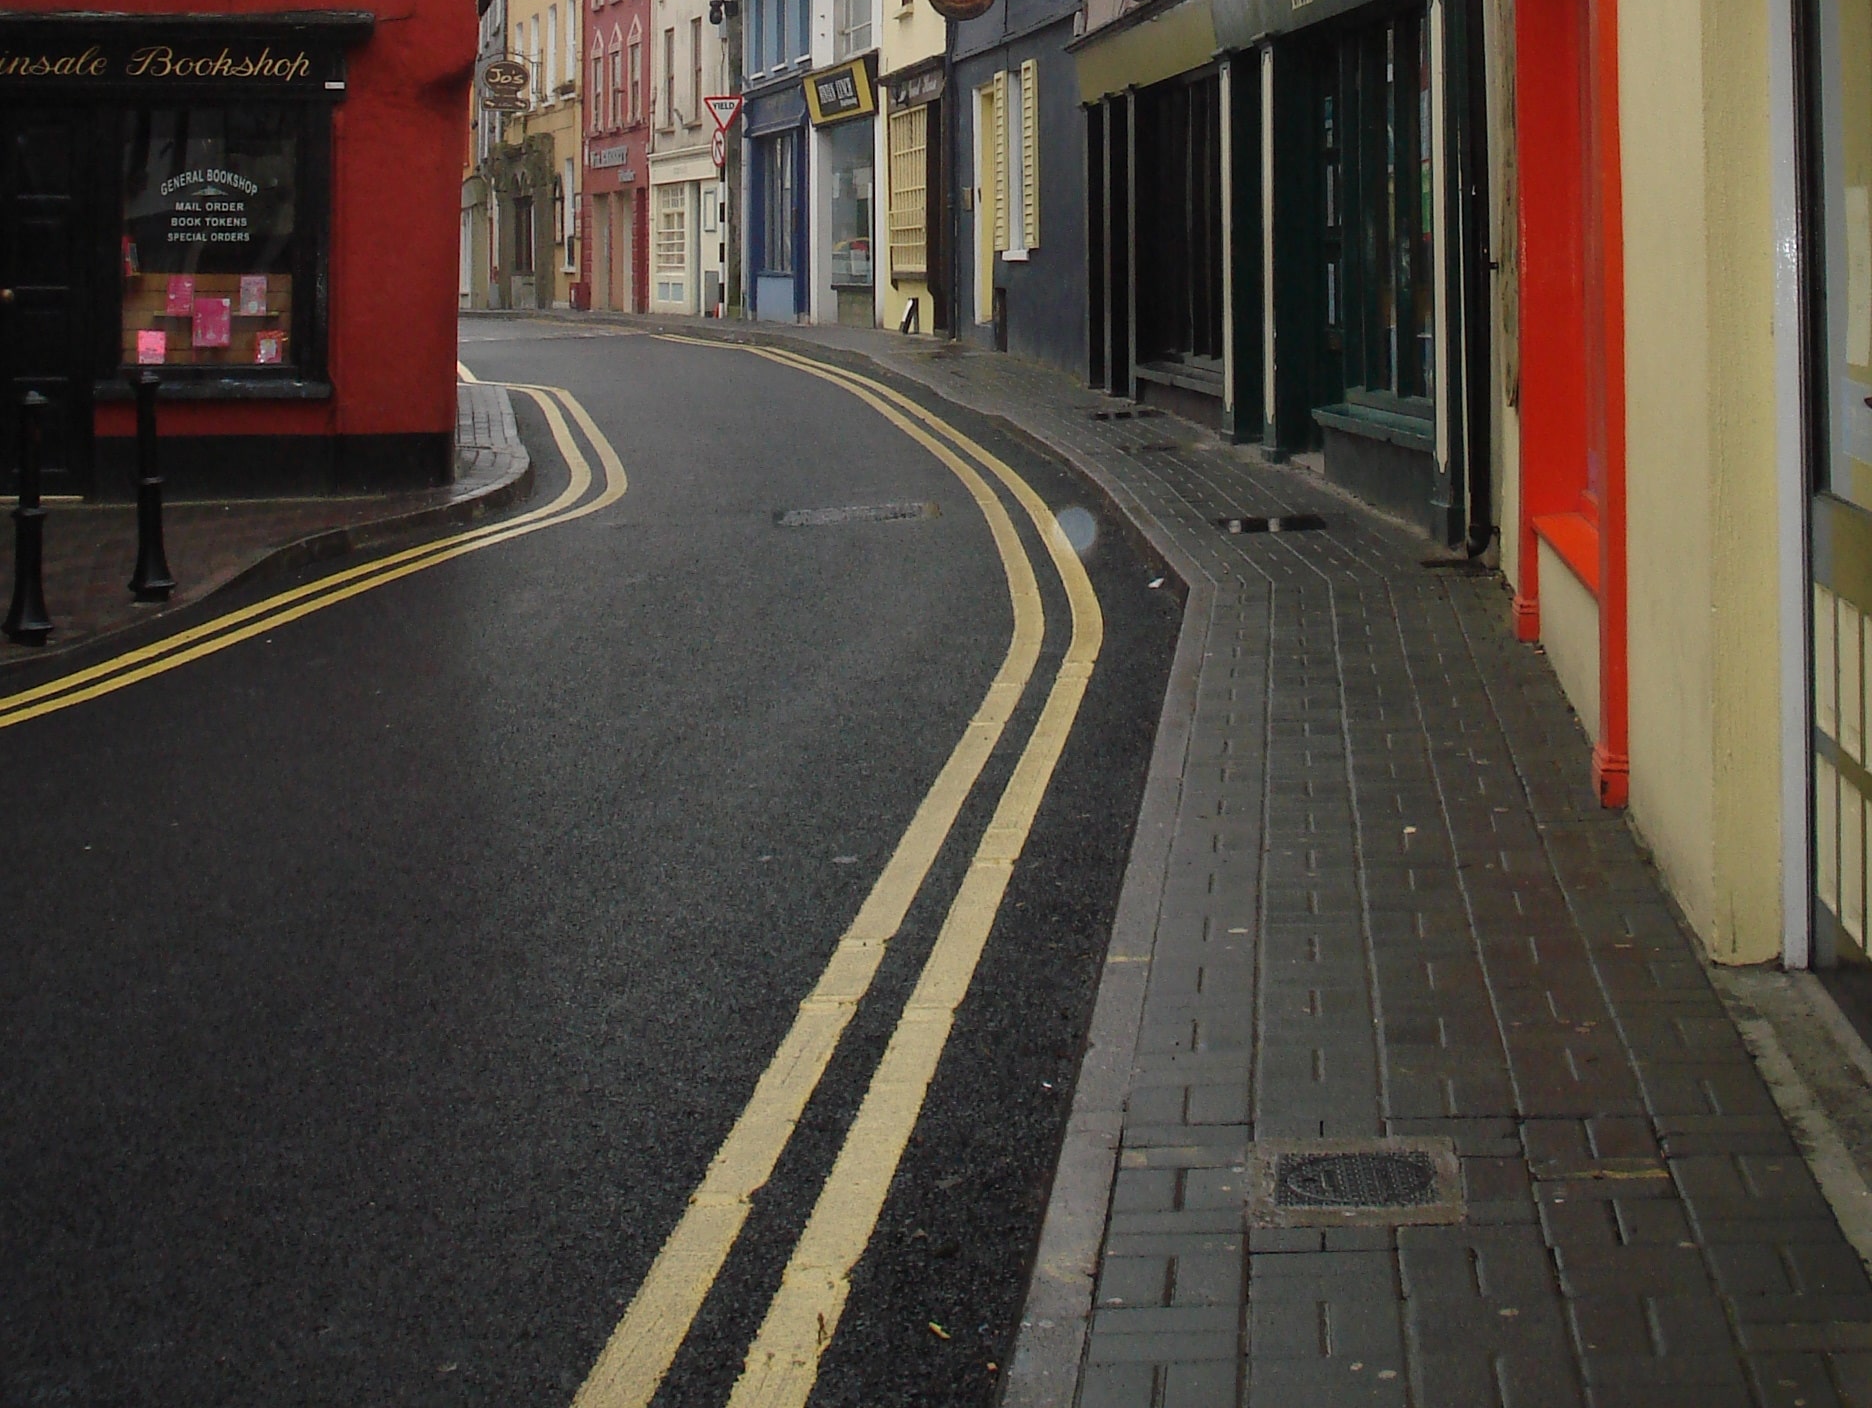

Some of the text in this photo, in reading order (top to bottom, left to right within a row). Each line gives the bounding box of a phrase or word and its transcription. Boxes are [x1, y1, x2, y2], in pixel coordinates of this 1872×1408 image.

[0, 45, 311, 82] insale Bookshop
[488, 68, 525, 84] Jo's
[712, 102, 735, 110] YIELD
[160, 169, 259, 197] GENERAL BOOKSHOP
[175, 201, 245, 212] MAIL ORDER
[170, 217, 248, 227] BOOK TOKENS
[167, 232, 250, 242] SPECIAL ORDERS
